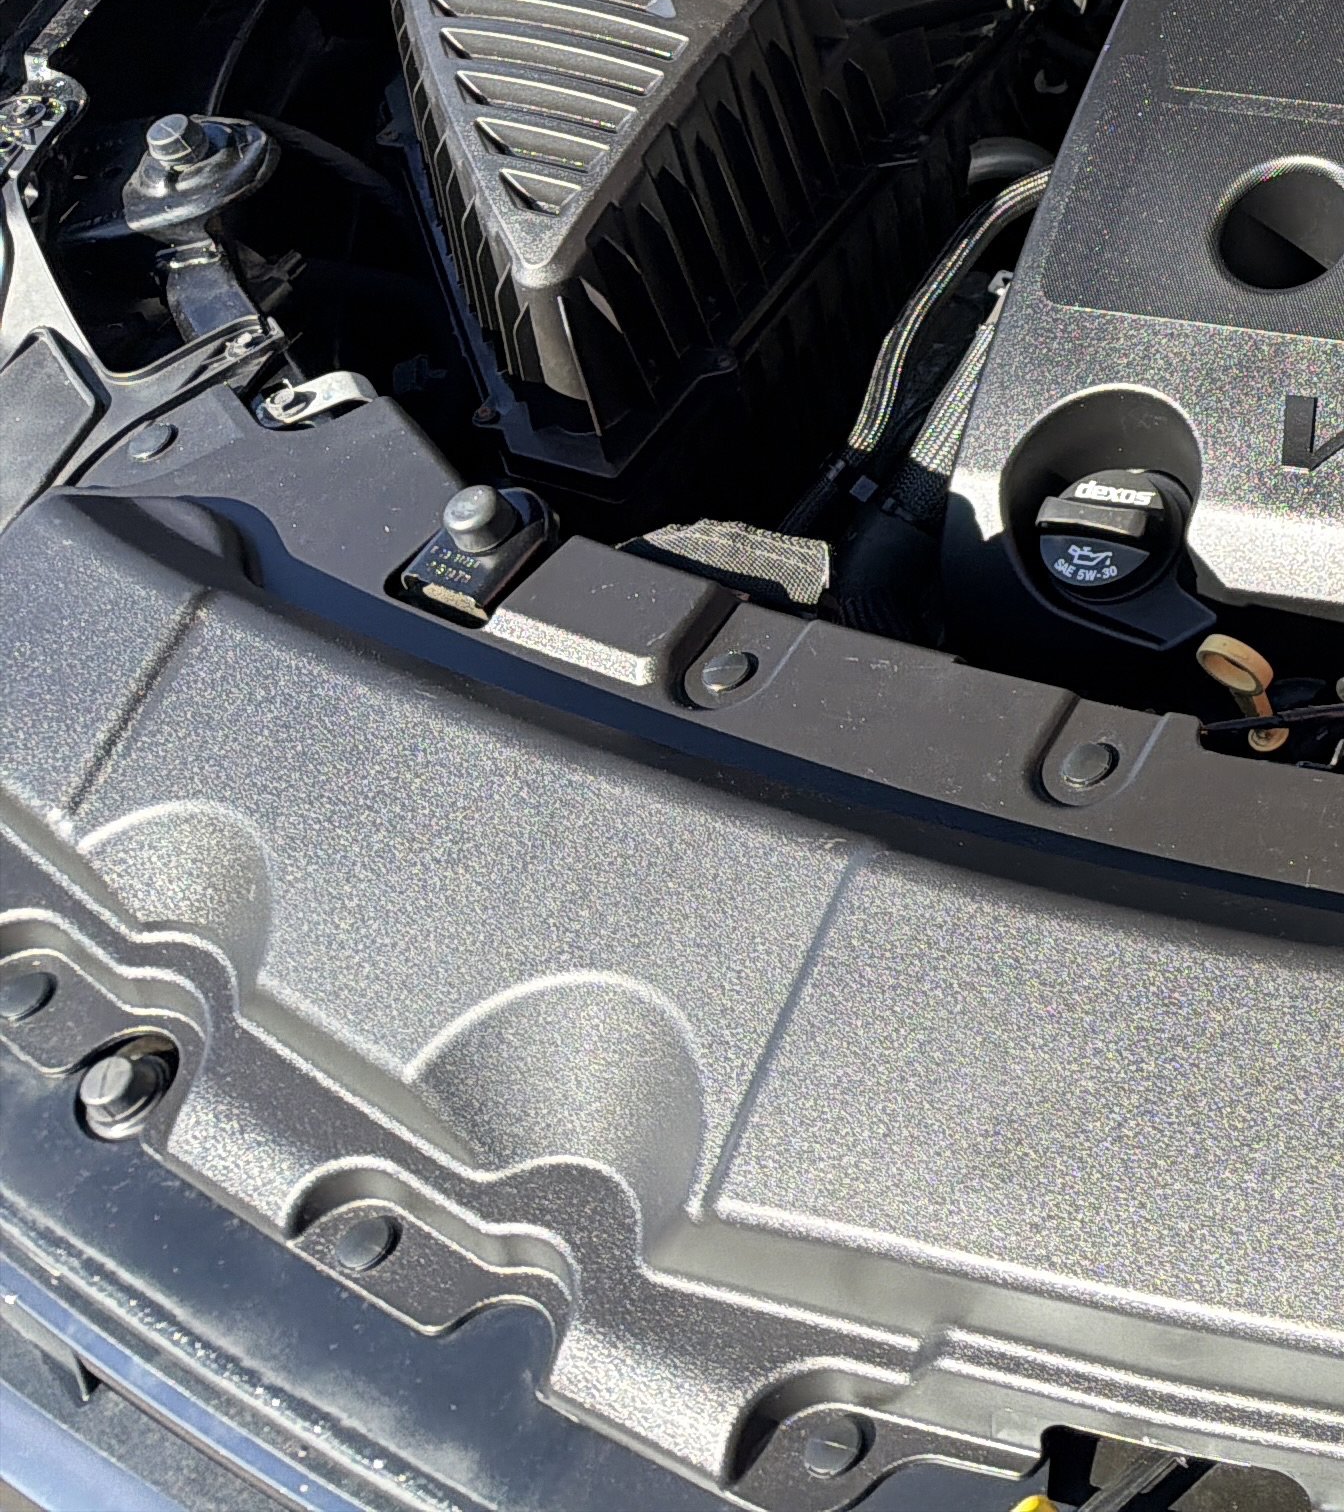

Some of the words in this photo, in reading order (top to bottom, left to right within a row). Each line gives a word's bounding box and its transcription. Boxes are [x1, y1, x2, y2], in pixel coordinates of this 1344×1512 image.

[1074, 479, 1156, 506] dexos
[1053, 558, 1076, 577] SAE
[1076, 565, 1117, 581] 5W-30
